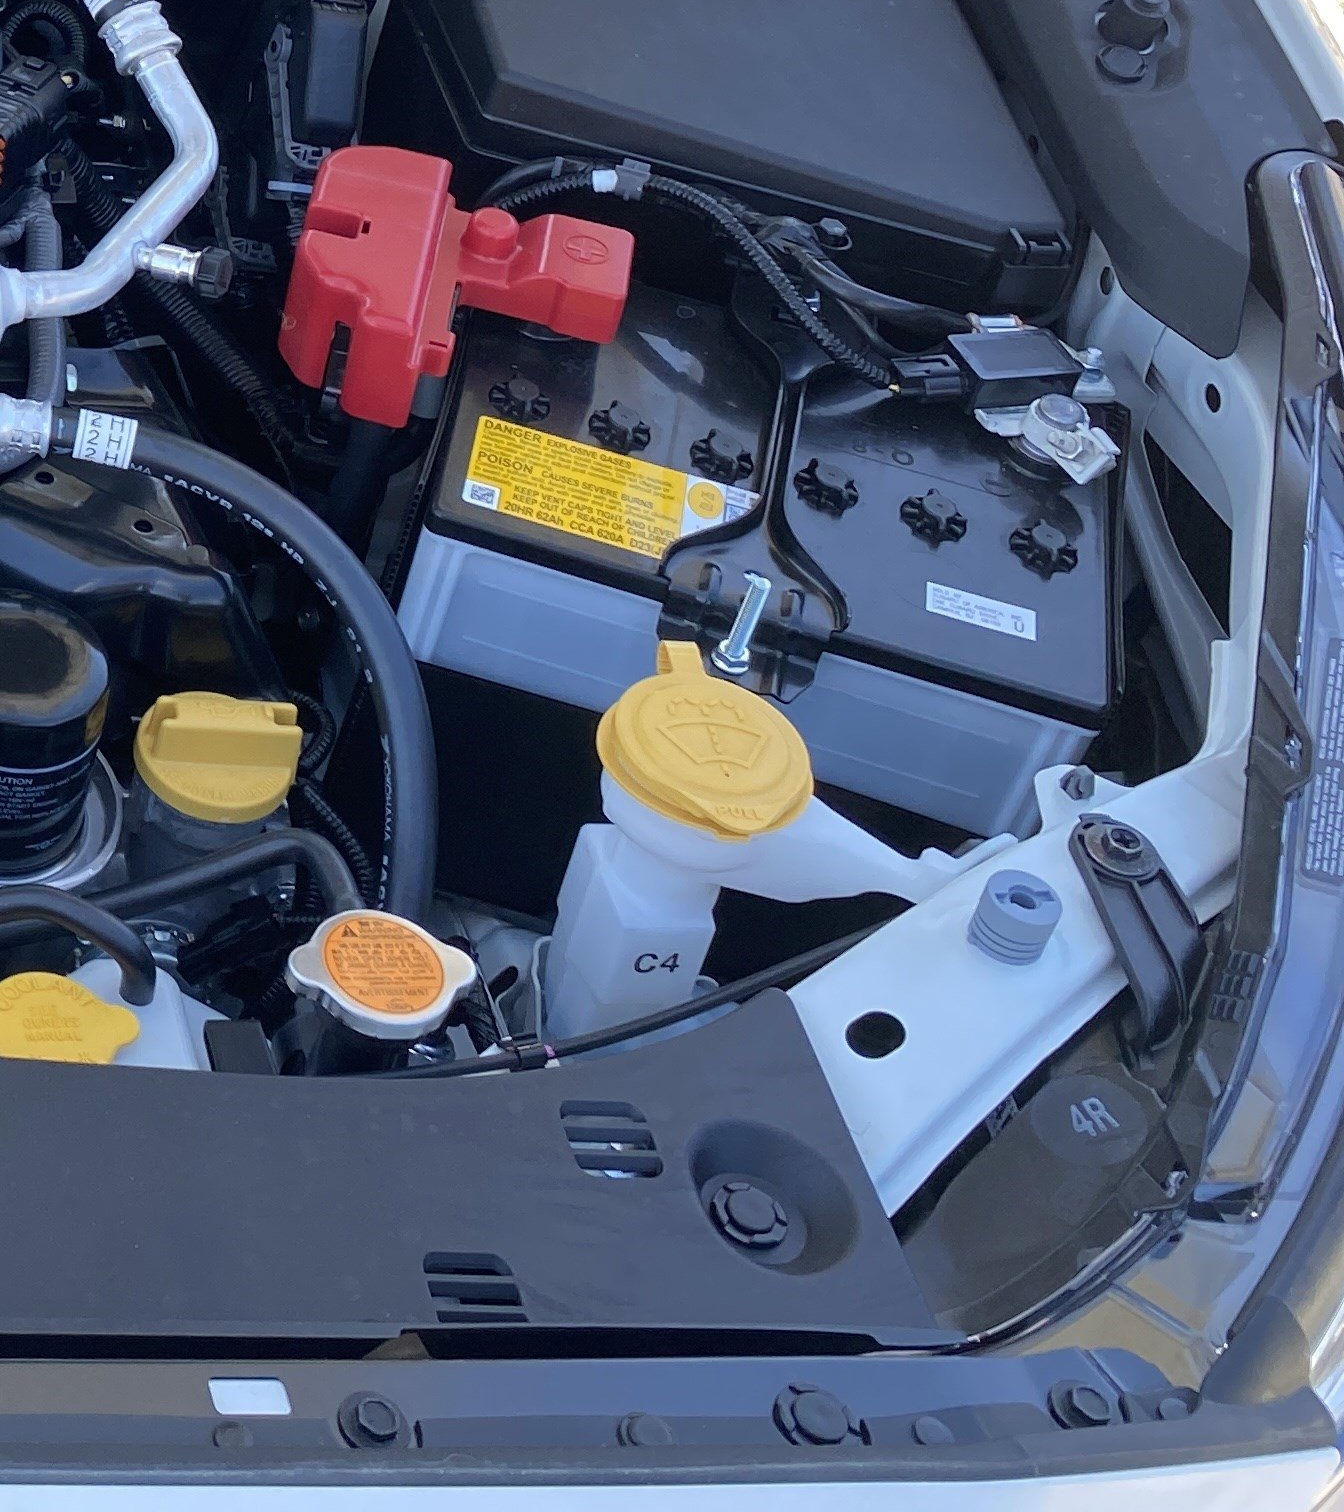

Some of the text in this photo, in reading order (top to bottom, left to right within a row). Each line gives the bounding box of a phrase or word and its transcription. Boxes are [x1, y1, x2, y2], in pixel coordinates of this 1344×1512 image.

[484, 419, 542, 443] DANGER
[478, 451, 533, 473] POISON
[541, 471, 579, 486] CAUSES
[582, 482, 617, 497] SEVERE
[504, 501, 533, 516] 20HR
[535, 511, 563, 525] 62Ah
[569, 521, 594, 534] CCA
[597, 529, 624, 543] 620A
[513, 494, 536, 505] KEEP
[539, 502, 557, 511] OUT
[576, 513, 609, 526] REACH
[514, 486, 538, 497] KEEP
[540, 493, 564, 505] VENT
[568, 502, 593, 513] CAPS
[596, 510, 622, 522] TIGHT
[626, 518, 644, 528] AND
[1014, 621, 1024, 633] U
[715, 805, 761, 820] PULL
[634, 952, 680, 973] C4
[1069, 1096, 1121, 1137] 4R
